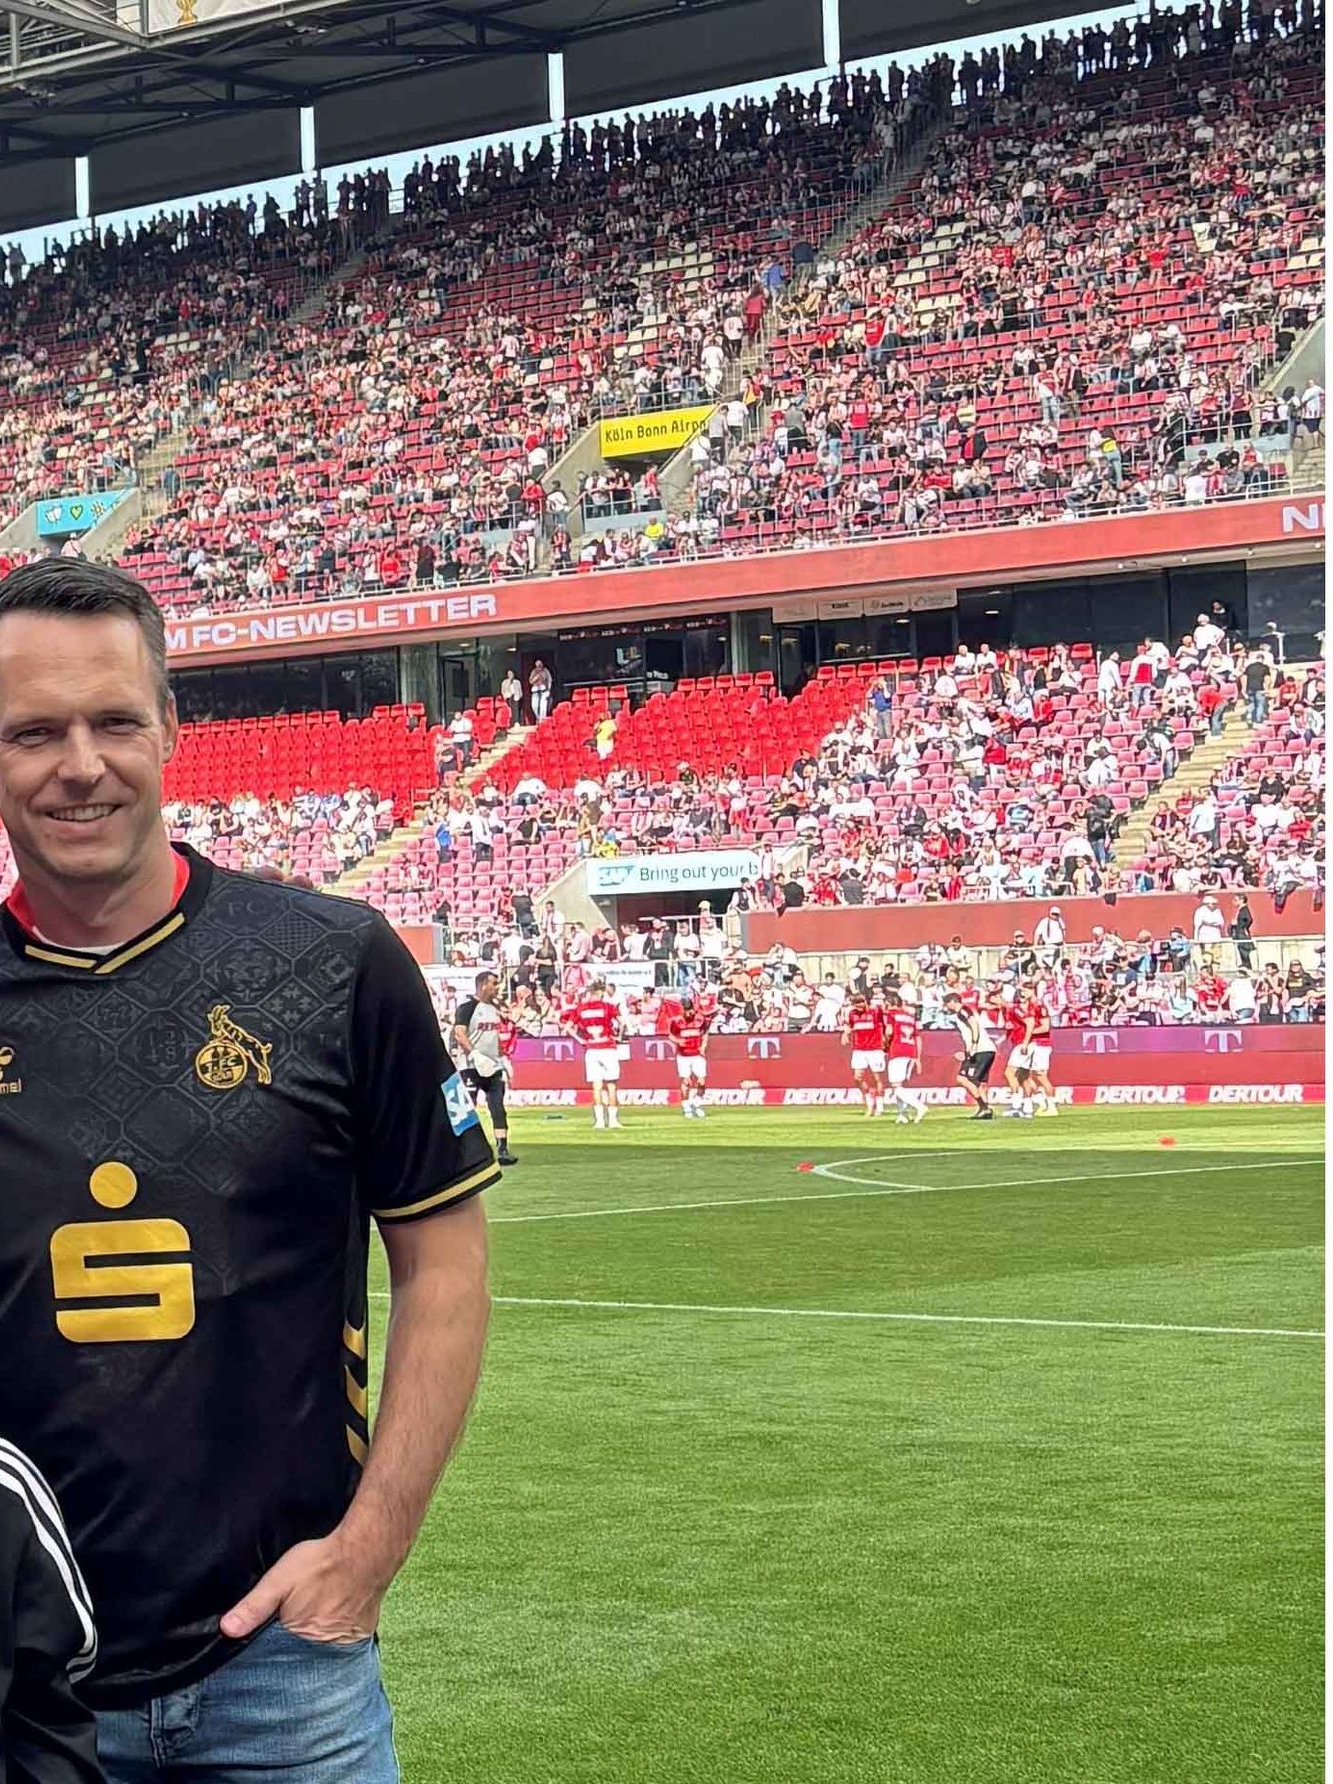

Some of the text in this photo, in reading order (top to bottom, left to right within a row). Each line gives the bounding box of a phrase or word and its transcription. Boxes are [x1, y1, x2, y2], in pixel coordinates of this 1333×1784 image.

[605, 427, 633, 443] Köln
[637, 425, 667, 439] Bonn
[193, 594, 498, 647] FC-NEWSLETTER
[640, 867, 678, 883] Bring
[683, 865, 707, 879] out
[711, 864, 745, 882] your
[1208, 1084, 1303, 1103] DERTOUR
